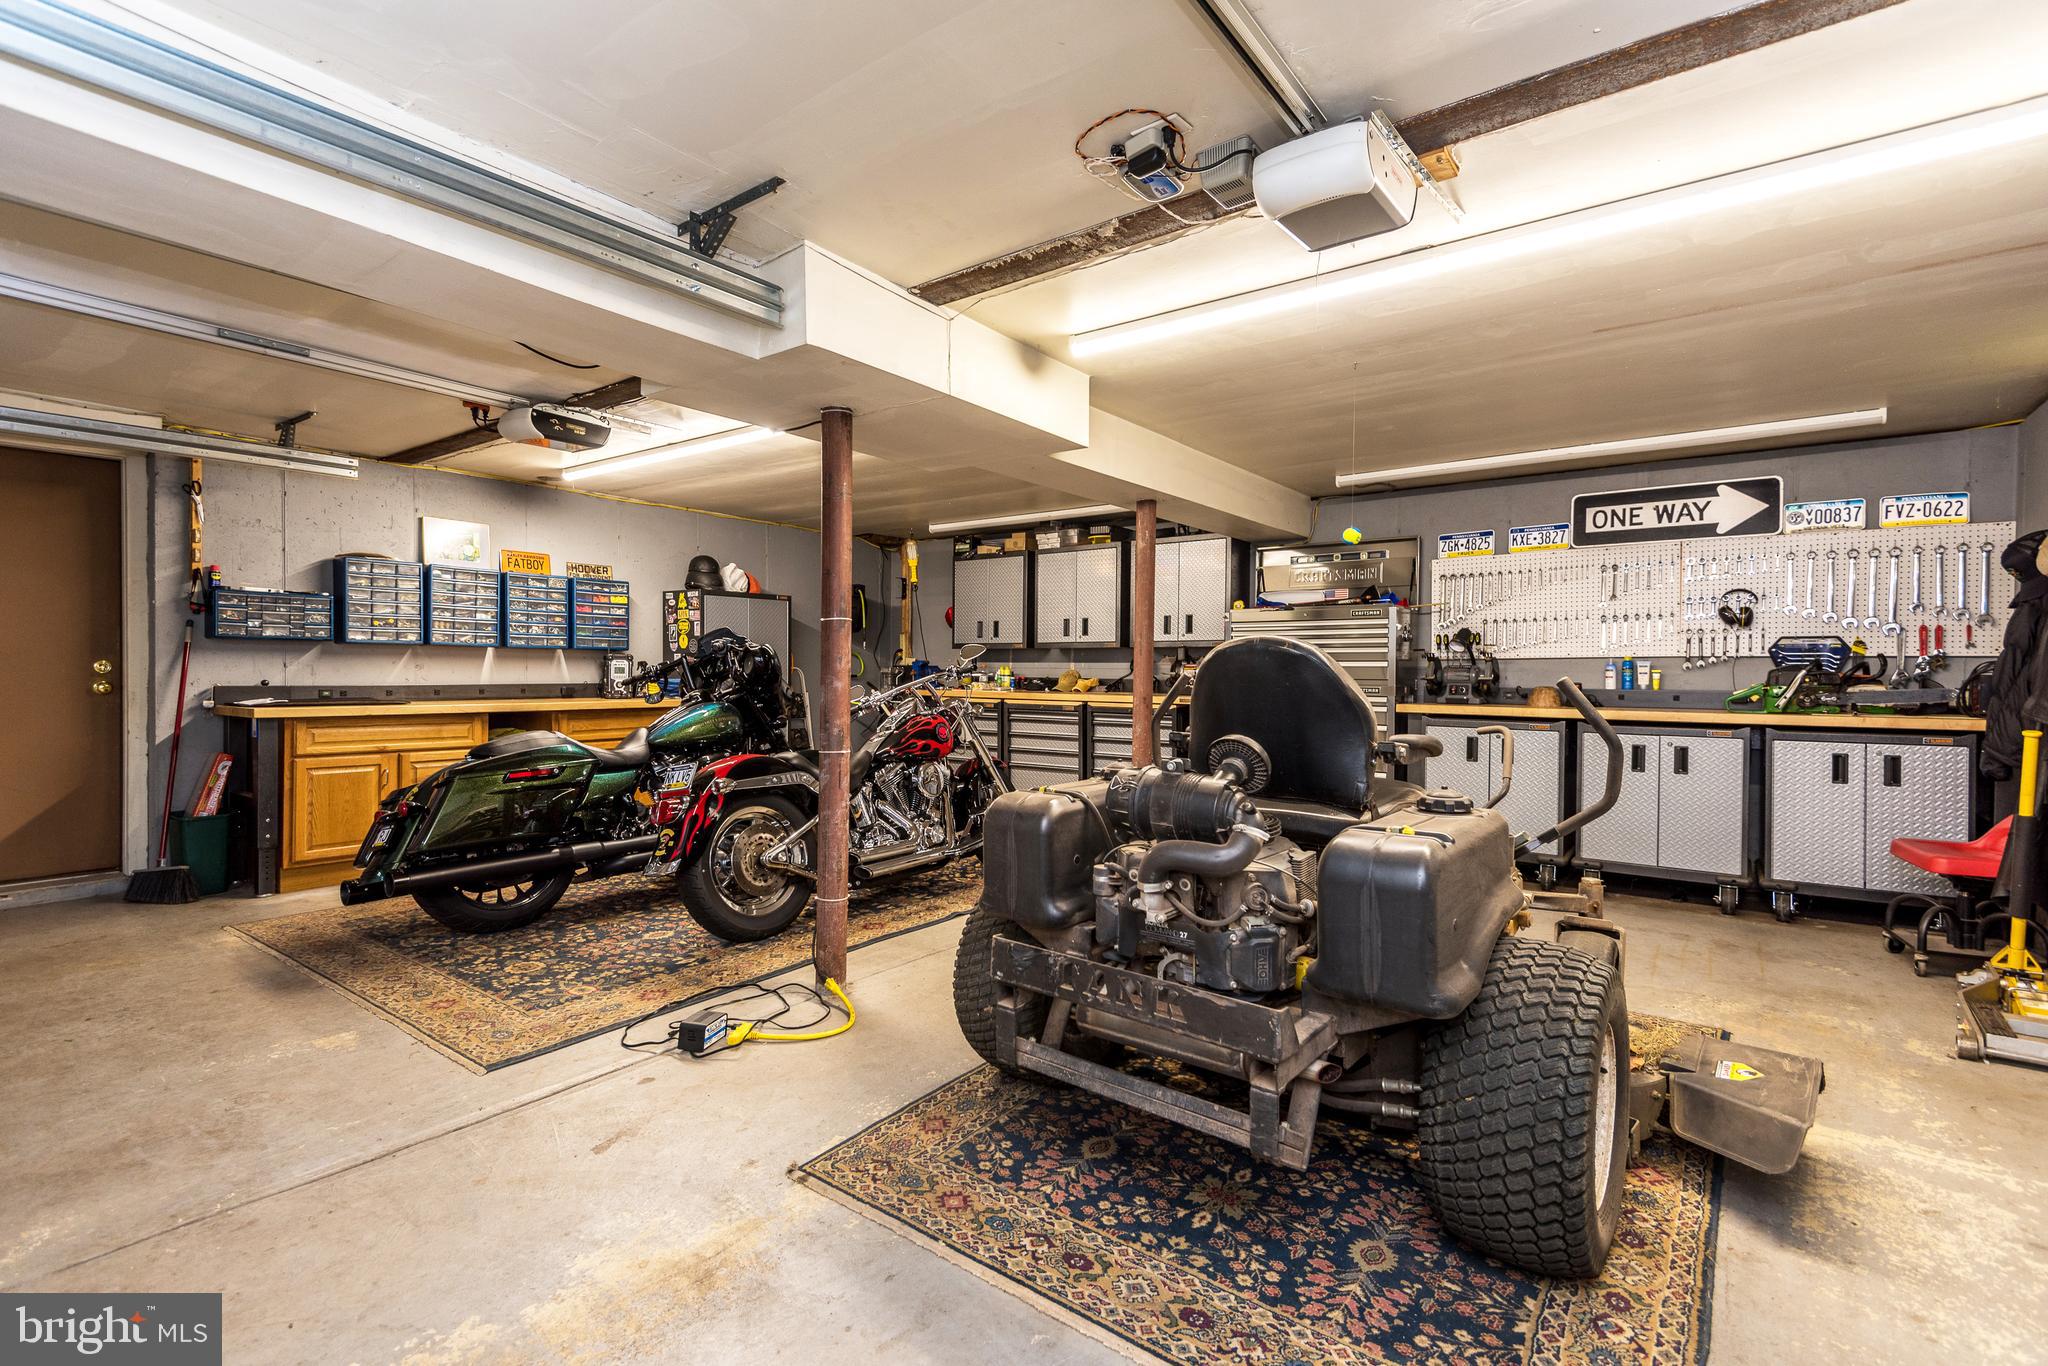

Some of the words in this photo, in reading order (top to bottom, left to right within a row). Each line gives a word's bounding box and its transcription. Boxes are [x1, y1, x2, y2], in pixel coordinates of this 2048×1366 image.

[1592, 506, 1643, 529] ONE
[1655, 500, 1712, 524] WAY
[507, 557, 545, 571] FATBOY
[571, 564, 609, 575] HOOVER
[1179, 930, 1188, 939] 27
